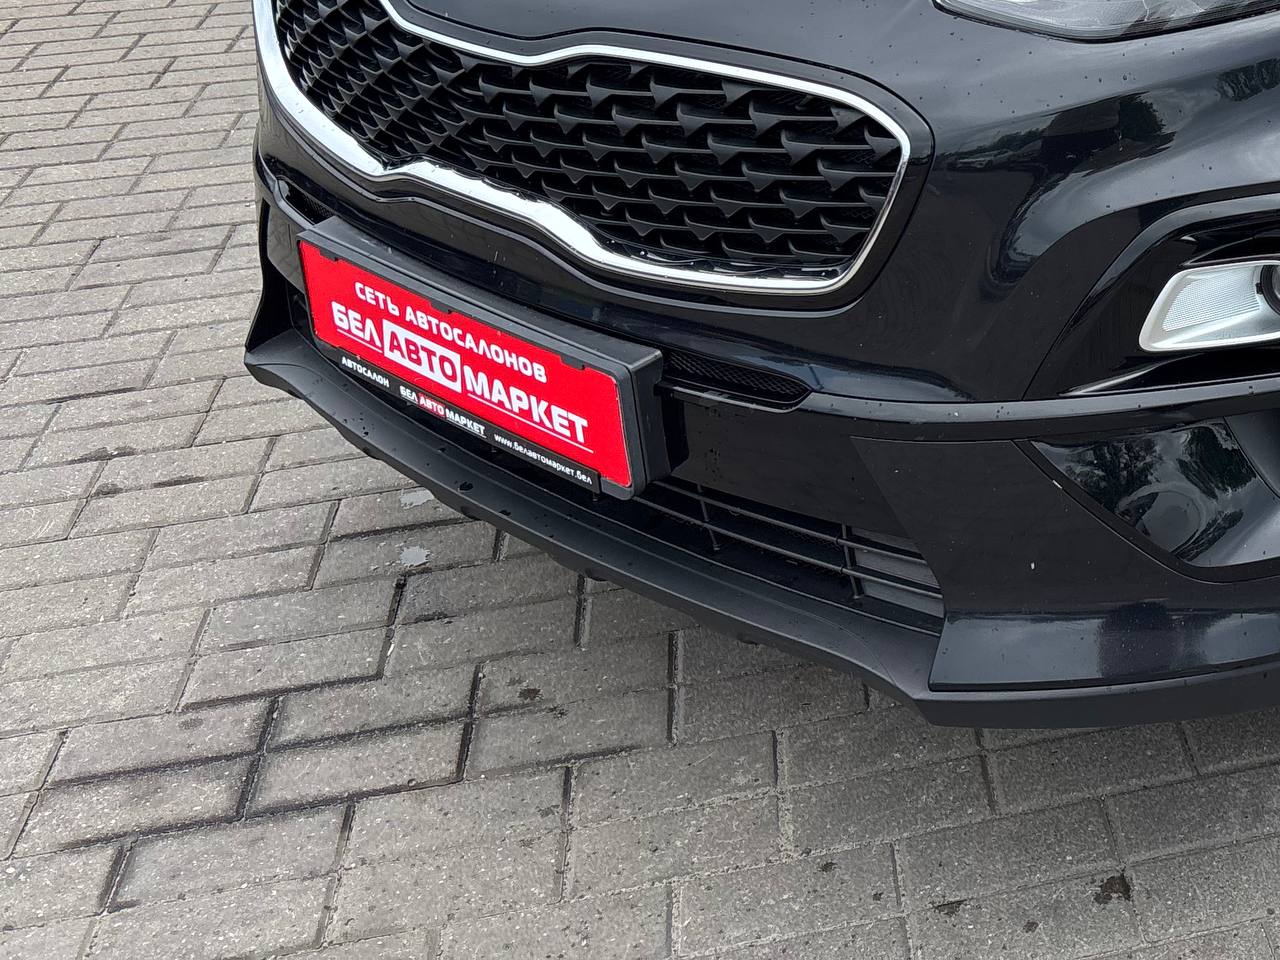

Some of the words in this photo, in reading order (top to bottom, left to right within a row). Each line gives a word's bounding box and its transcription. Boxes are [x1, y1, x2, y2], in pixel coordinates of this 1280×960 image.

[331, 302, 382, 347] БЕЛ
[387, 329, 460, 385] АВТО
[464, 364, 588, 444] МАРКЕТ
[355, 281, 400, 317] СЕТЬ
[405, 306, 547, 384] АВТОСАЛОНОВ
[341, 356, 390, 388] АВТОСАЛОН
[494, 434, 593, 485] www.белавтомаркет.бел
